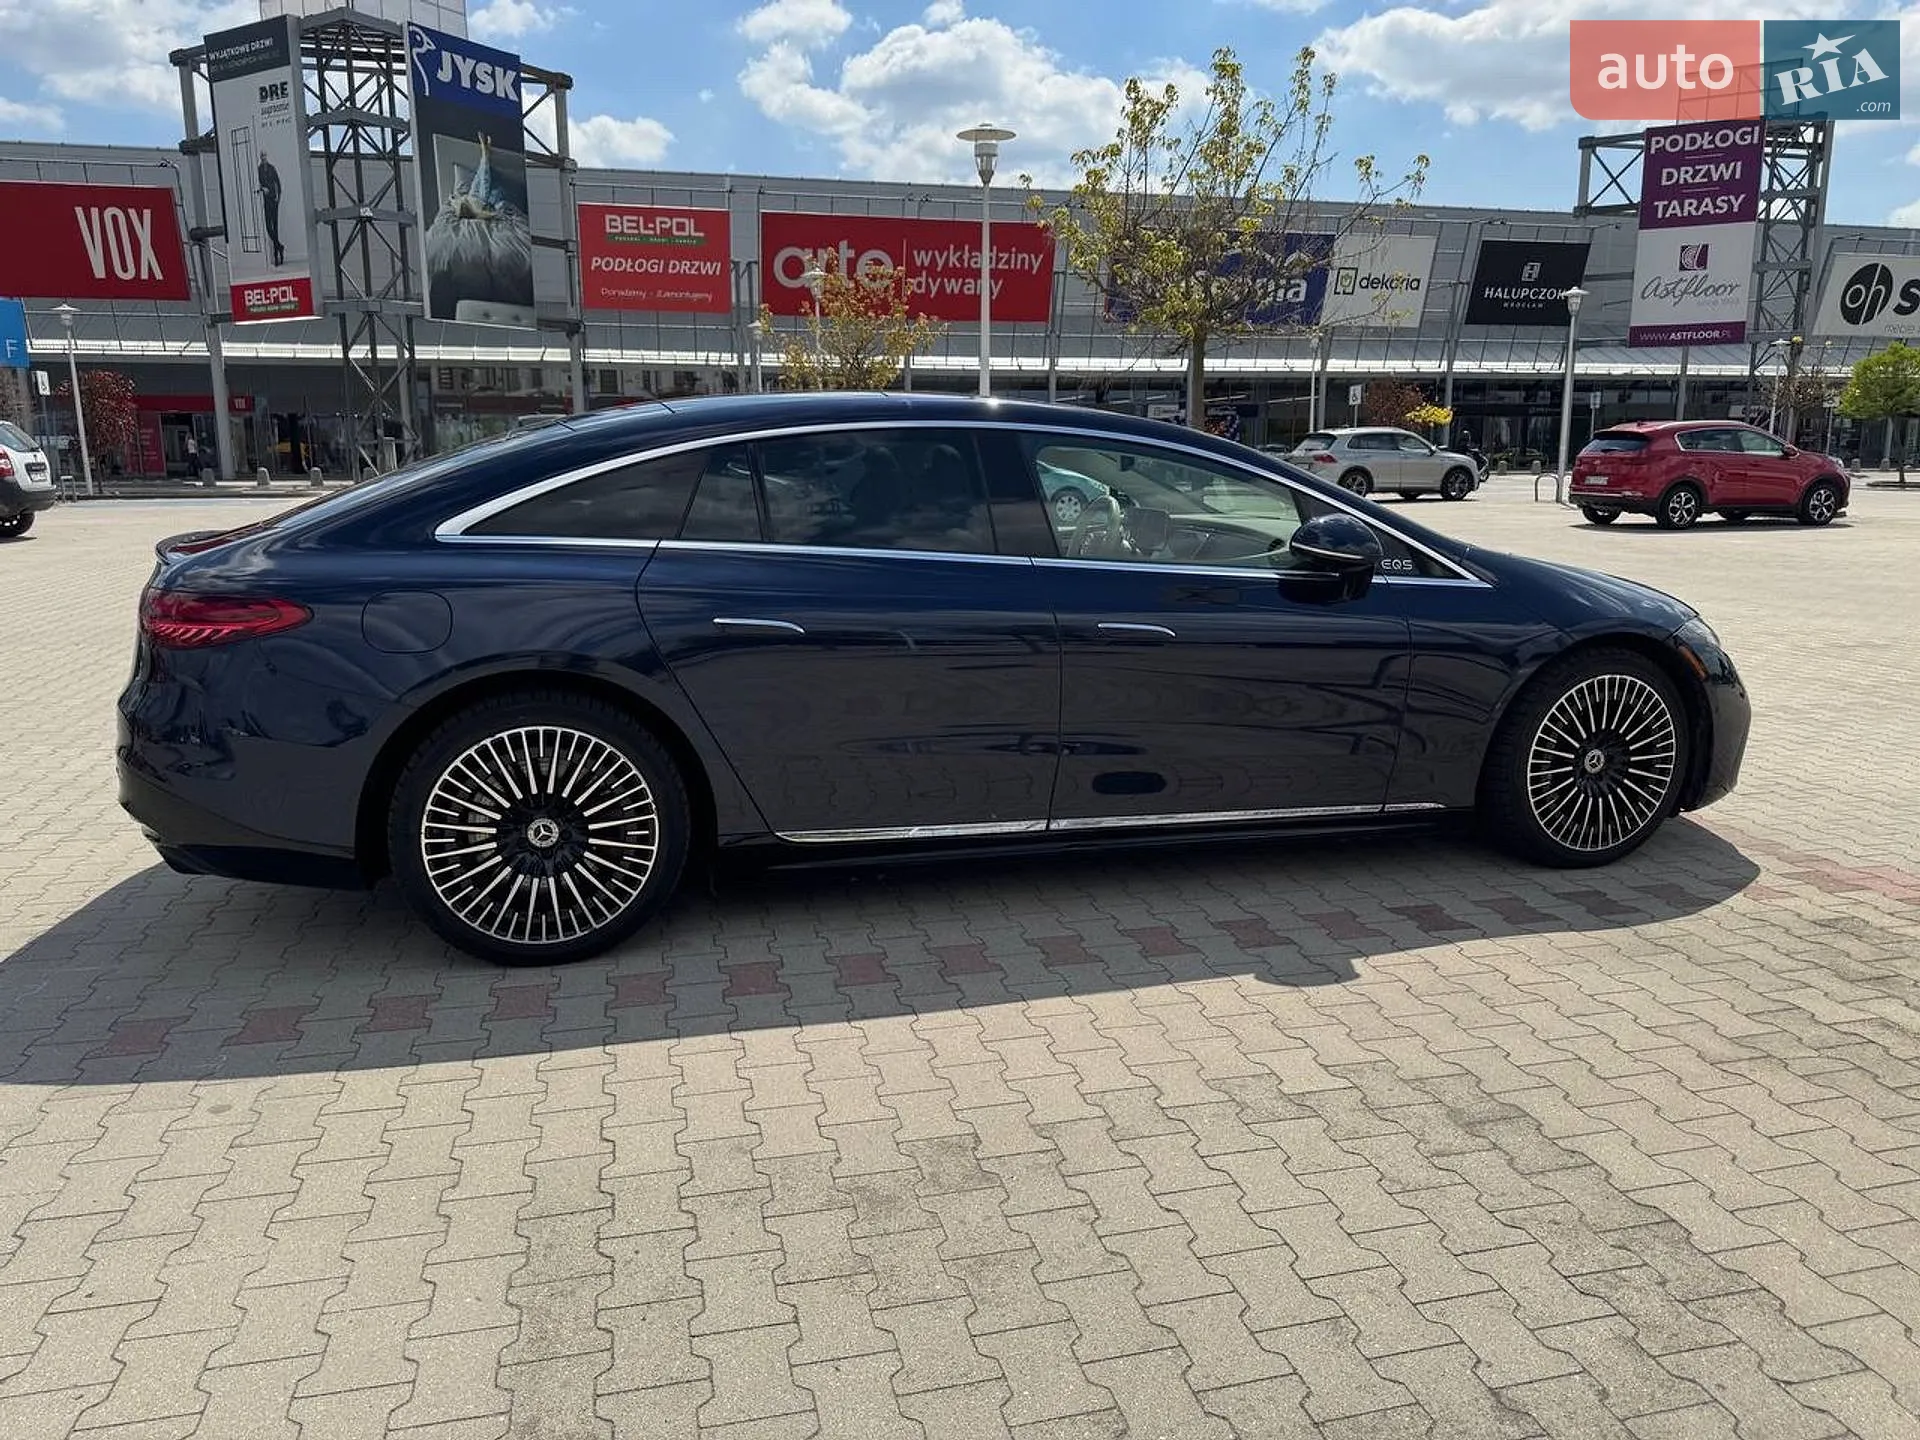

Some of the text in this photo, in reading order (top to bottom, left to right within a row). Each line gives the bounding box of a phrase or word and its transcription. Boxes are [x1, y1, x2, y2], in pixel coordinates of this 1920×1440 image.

[437, 50, 519, 102] JYSK
[259, 81, 289, 103] DRE
[1650, 126, 1760, 154] PODŁOGI
[1661, 161, 1742, 187] DRZWI
[1654, 194, 1746, 219] TARASY
[605, 214, 705, 237] BEL-POL
[74, 206, 164, 280] VOX
[591, 256, 722, 276] PODŁOGI DRZWI
[913, 244, 1044, 275] wykładziny
[244, 285, 299, 306] BEL-POL
[6, 339, 19, 358] F
[1381, 559, 1413, 570] EQS
